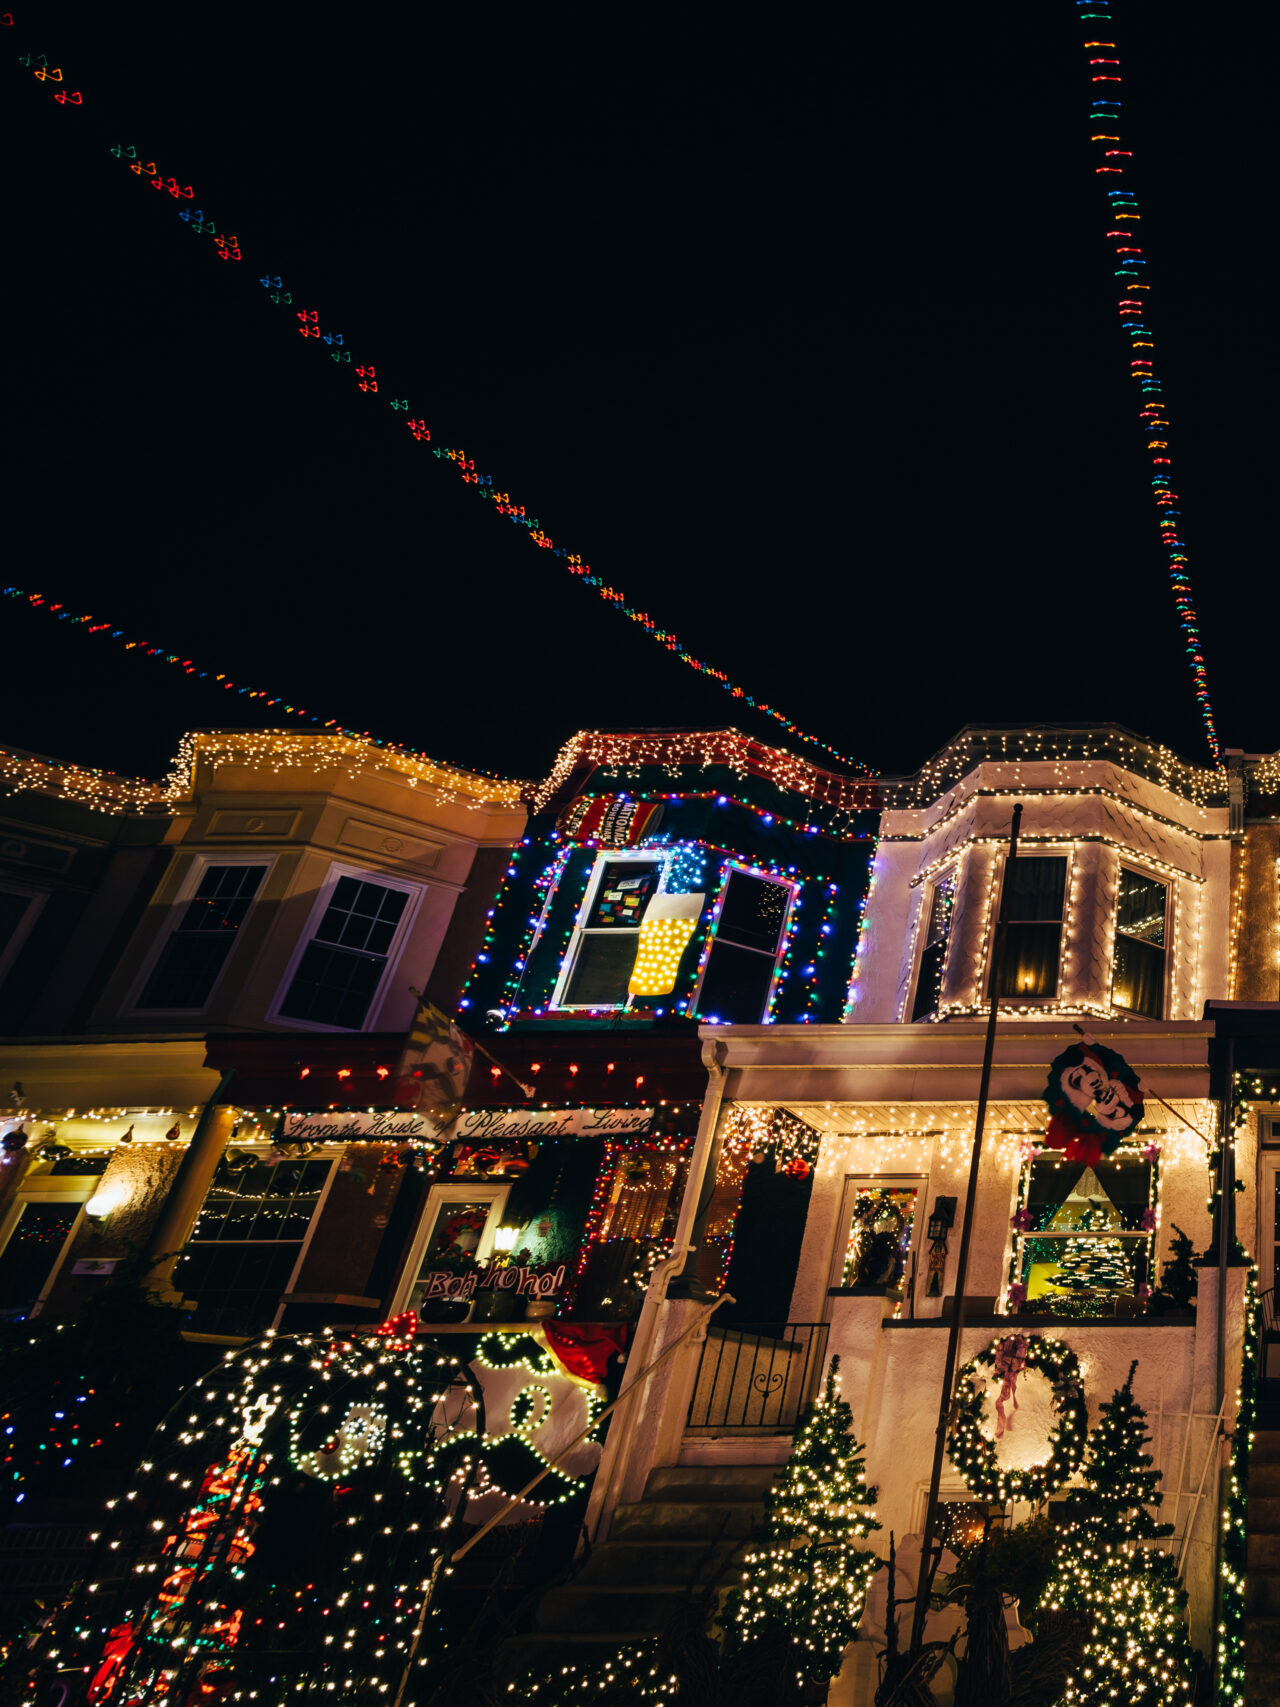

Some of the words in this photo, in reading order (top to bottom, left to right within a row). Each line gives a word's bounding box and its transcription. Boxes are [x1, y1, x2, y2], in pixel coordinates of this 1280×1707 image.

[577, 801, 590, 816] PALE
[603, 803, 621, 840] BOHEMIAN
[614, 801, 636, 842] NATIONAL
[289, 1114, 339, 1138] From
[338, 1119, 362, 1134] the
[363, 1112, 424, 1137] House
[457, 1110, 574, 1138] Pleasant
[582, 1108, 652, 1131] Living
[425, 1270, 478, 1299] Boh
[480, 1261, 518, 1289] ho
